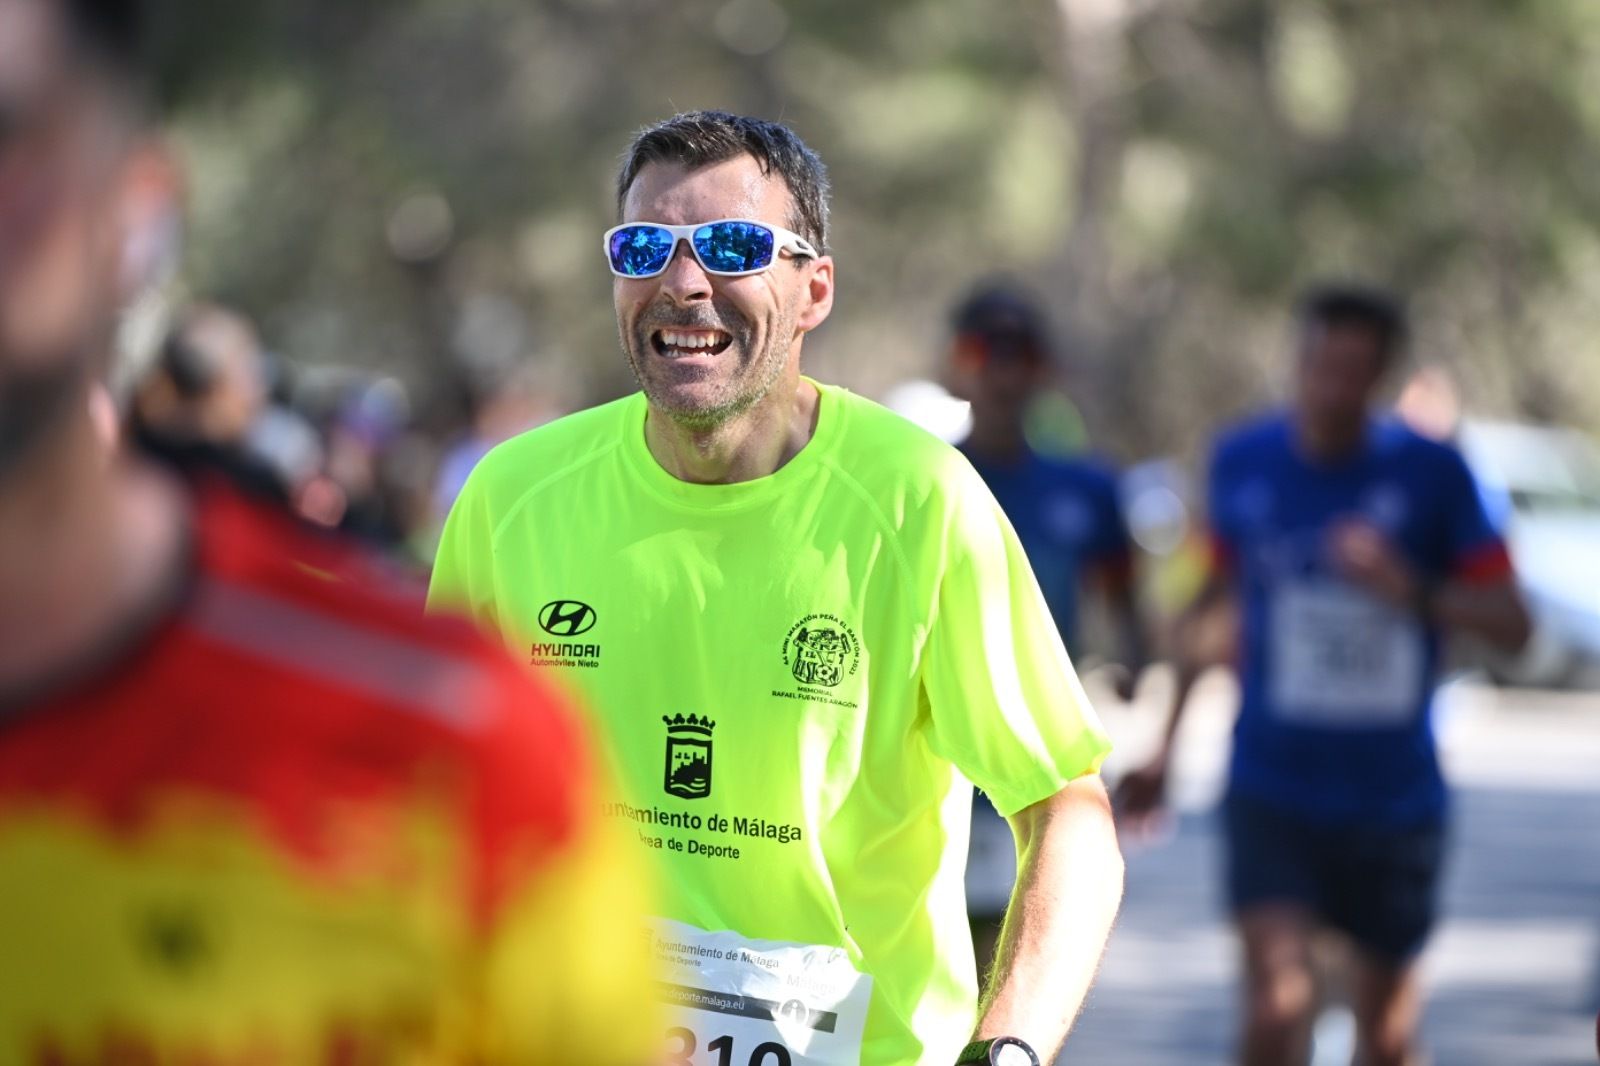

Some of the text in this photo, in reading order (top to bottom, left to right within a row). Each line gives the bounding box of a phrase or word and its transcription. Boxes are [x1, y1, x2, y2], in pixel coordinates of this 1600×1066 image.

[819, 613, 839, 623] PEÑA
[839, 620, 847, 629] EL
[846, 628, 860, 657] BASTÓN
[531, 643, 600, 657] HYUNDAI
[530, 658, 599, 668] Automóviles Nieto
[772, 690, 796, 699] RAFAEL
[798, 693, 827, 703] FUENTES
[797, 686, 832, 697] MEMORIAL
[600, 801, 802, 844] untamiento de Málaga
[667, 837, 683, 852] de
[687, 839, 740, 860] Deporte
[725, 949, 738, 961] de
[740, 950, 780, 969] Málaga
